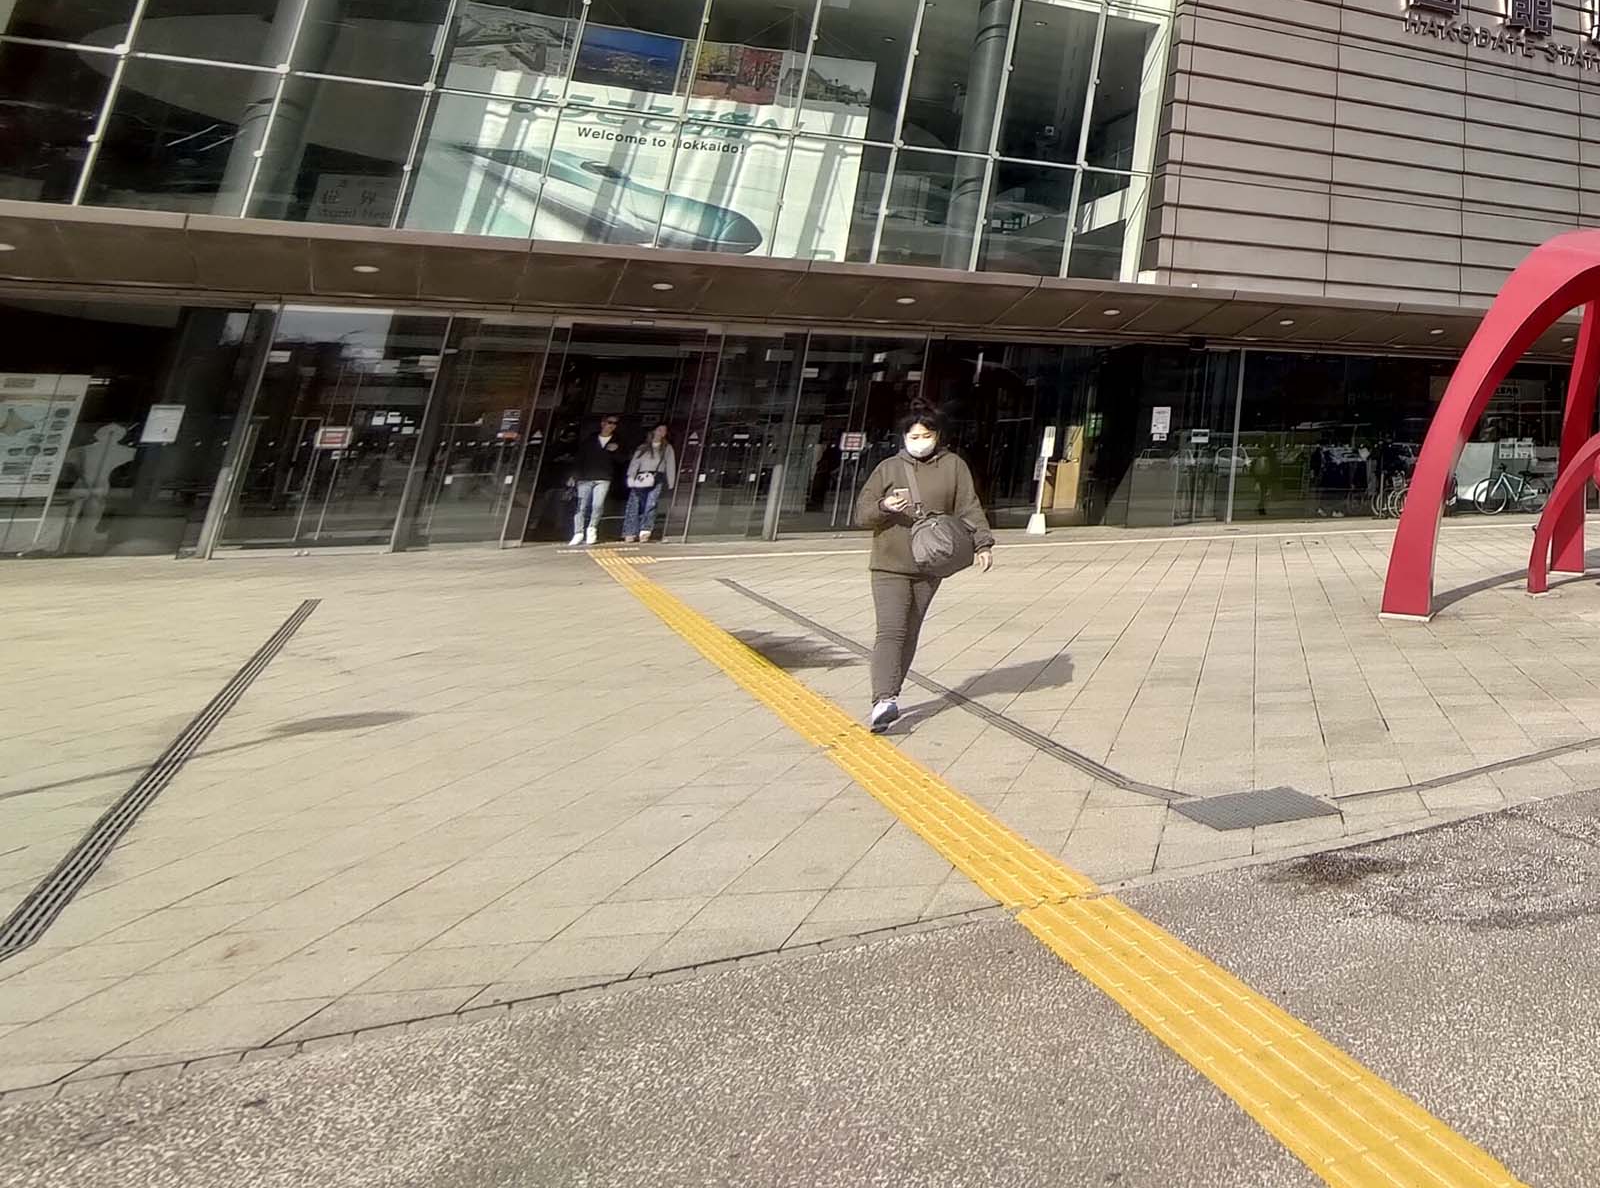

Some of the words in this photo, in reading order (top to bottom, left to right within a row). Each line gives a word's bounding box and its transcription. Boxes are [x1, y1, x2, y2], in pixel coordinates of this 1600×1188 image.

[1403, 10, 1536, 58] HAKODATE
[577, 126, 648, 147] Welcome
[651, 138, 667, 149] to
